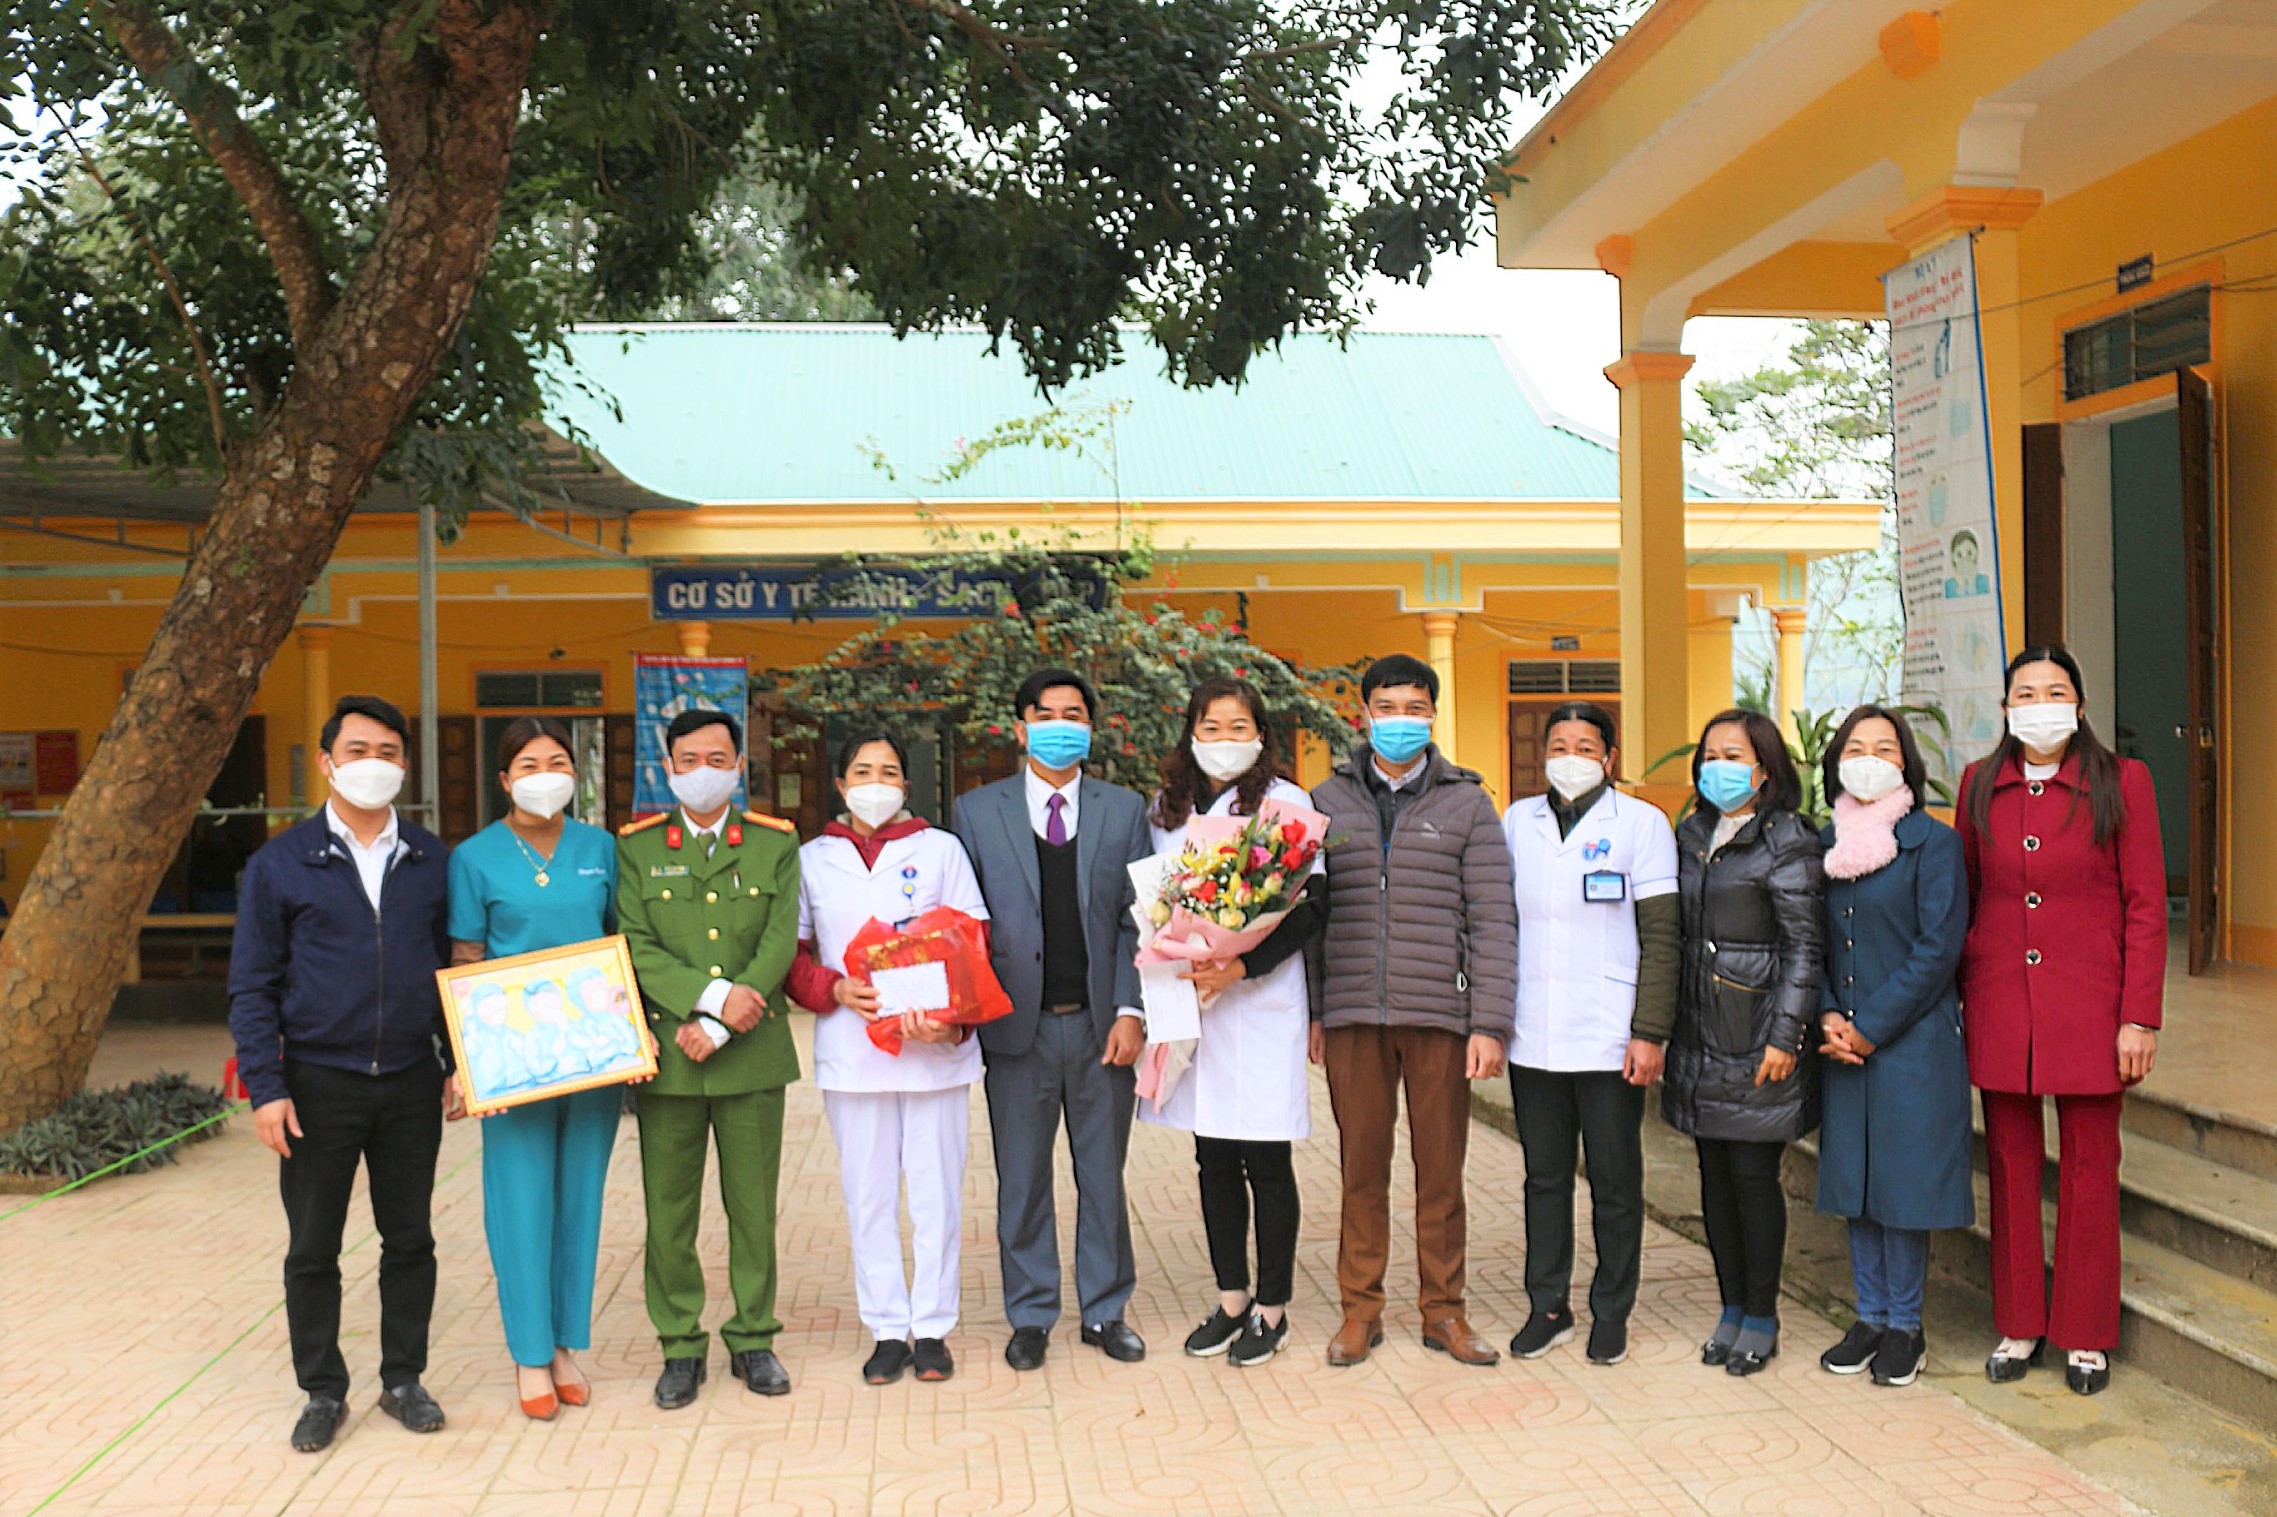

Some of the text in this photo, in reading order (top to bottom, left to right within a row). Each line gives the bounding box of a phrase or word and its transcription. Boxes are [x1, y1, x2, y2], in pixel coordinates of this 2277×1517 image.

[667, 579, 708, 609] CƠ
[714, 570, 755, 609] SỞ
[761, 581, 780, 609] Y
